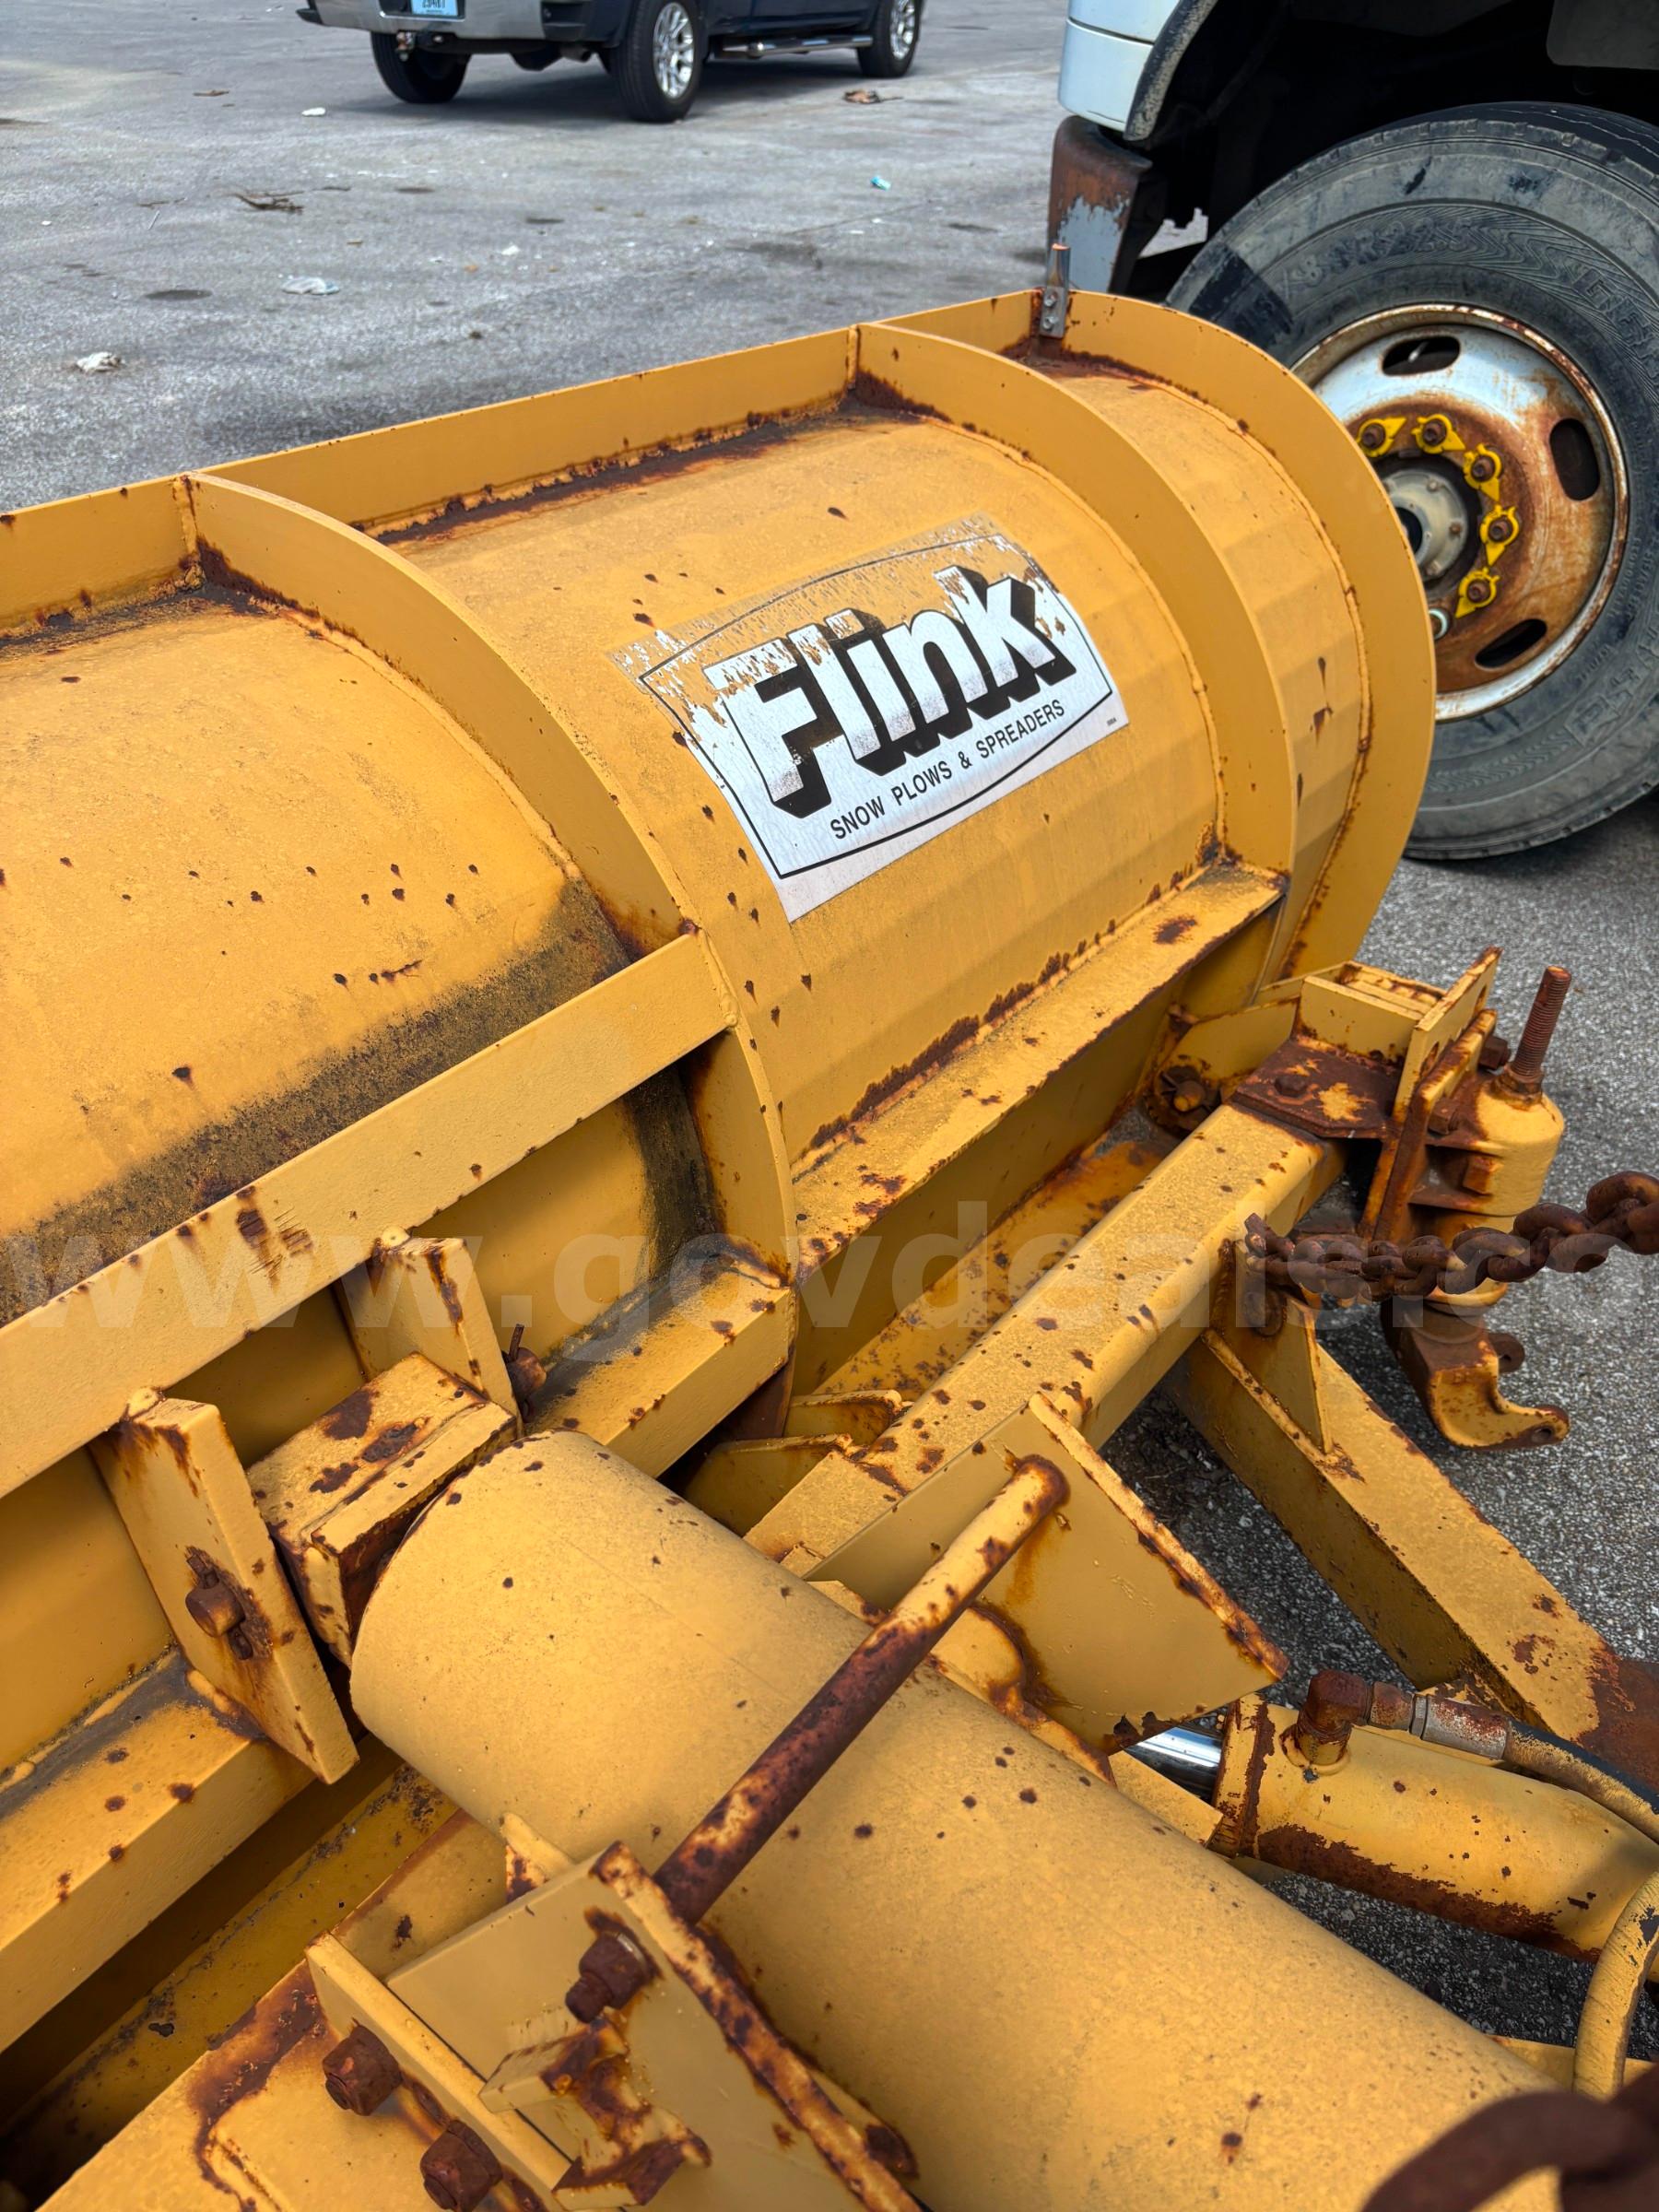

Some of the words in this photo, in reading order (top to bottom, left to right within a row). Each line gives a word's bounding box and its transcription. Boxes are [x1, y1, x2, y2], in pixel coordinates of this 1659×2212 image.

[702, 565, 1077, 818] Flink
[830, 795, 886, 840] SNOW
[890, 760, 953, 806] PLOWS
[958, 750, 972, 770] &
[975, 699, 1065, 759] SPREADERS
